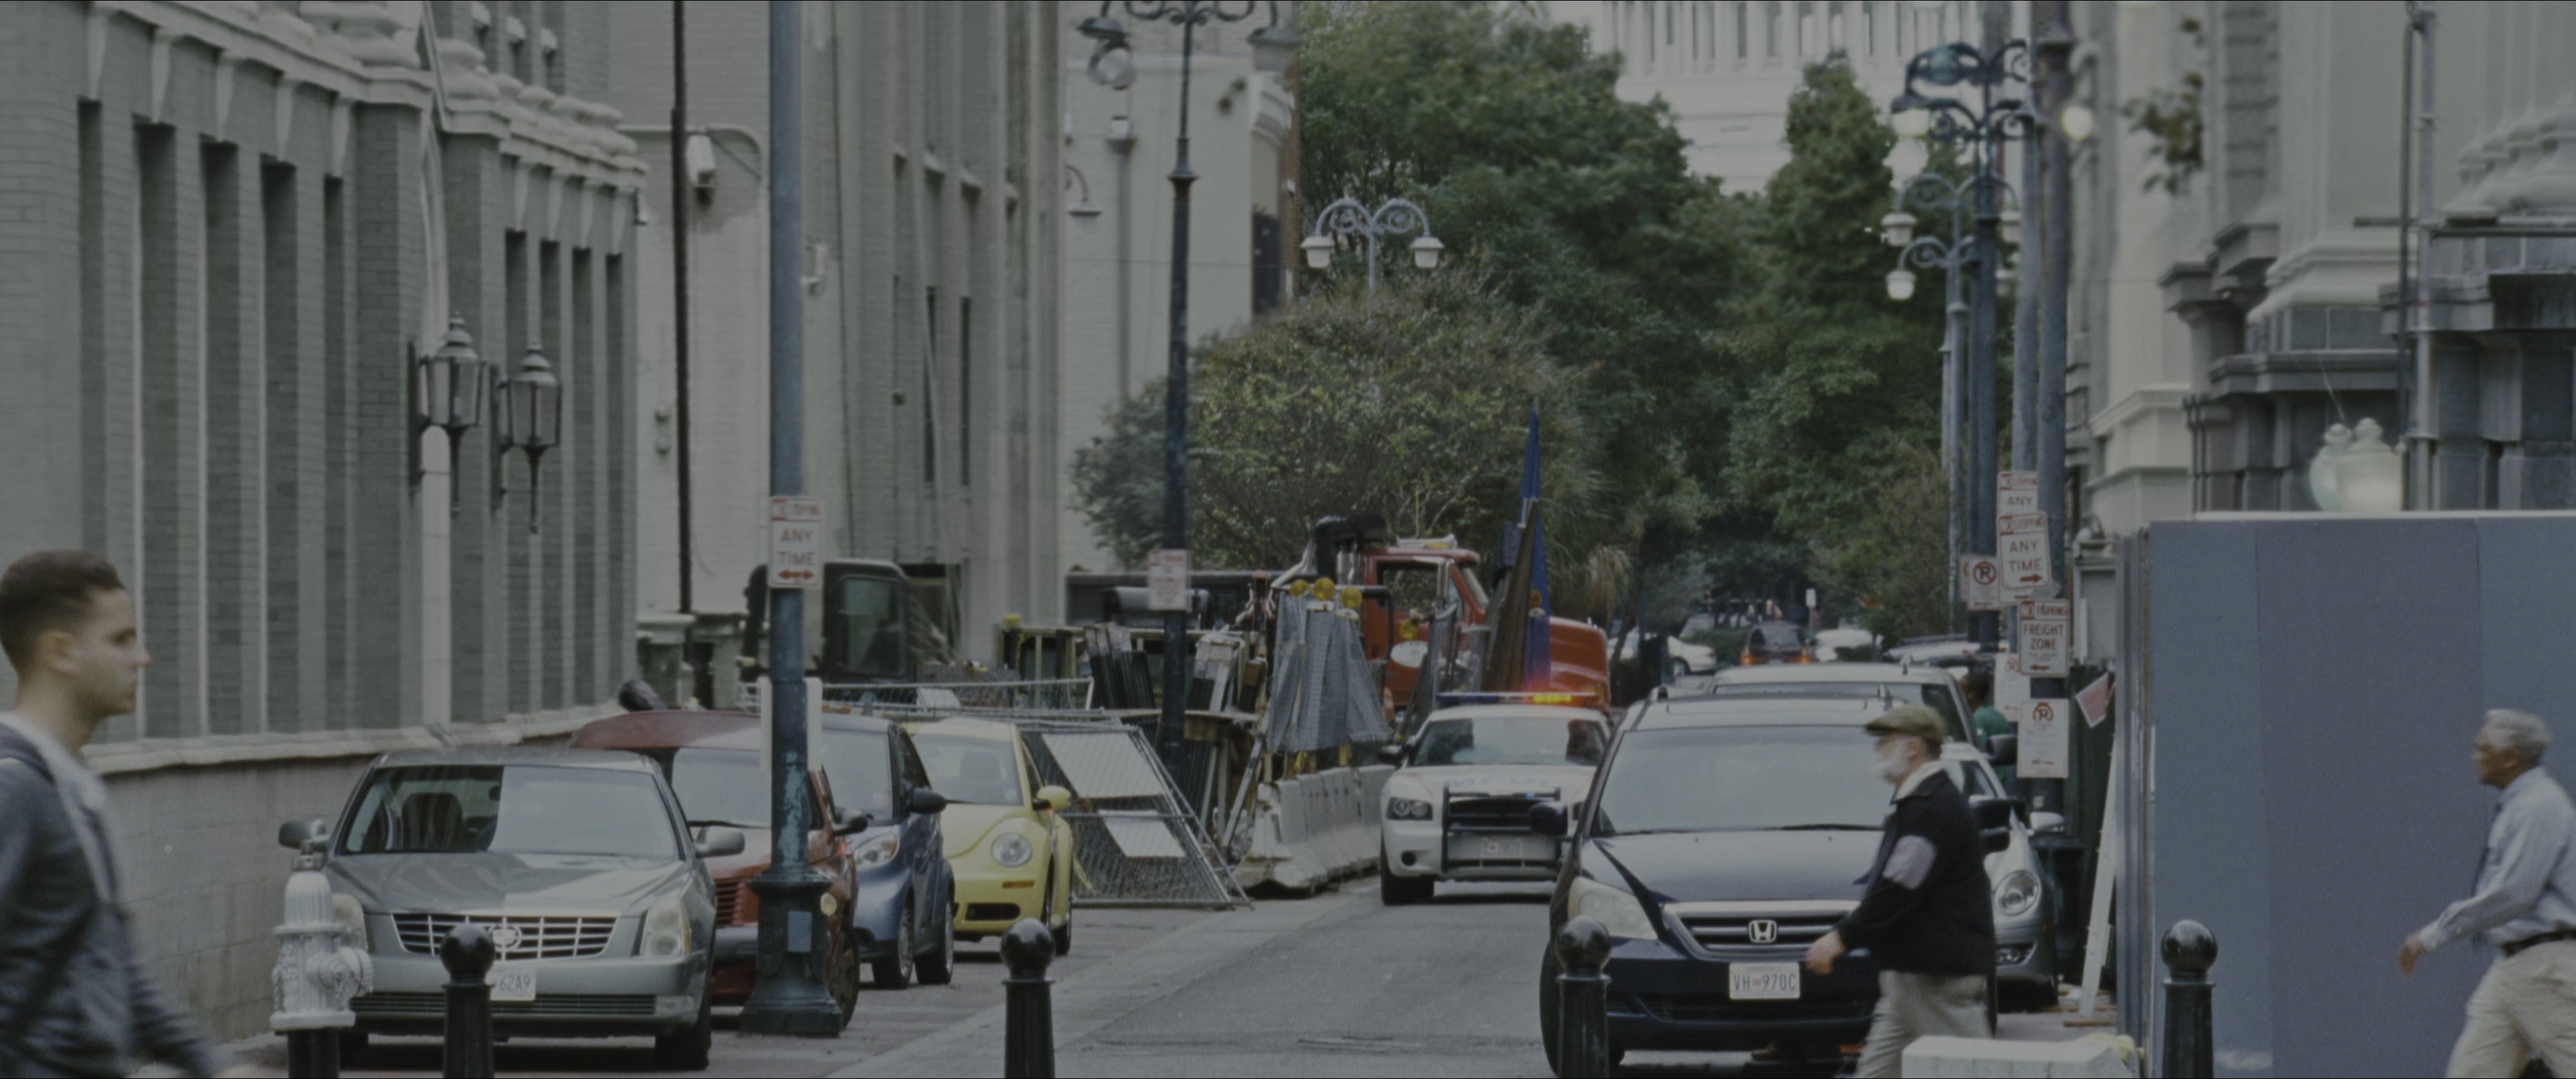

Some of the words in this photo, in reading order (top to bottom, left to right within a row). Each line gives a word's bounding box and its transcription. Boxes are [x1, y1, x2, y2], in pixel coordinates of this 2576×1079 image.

[2007, 496, 2033, 505] ANY
[781, 528, 813, 542] ANY
[2010, 540, 2038, 553] ANY
[778, 551, 816, 566] TIME
[2008, 558, 2042, 572] TIME
[2023, 623, 2063, 636] FREIGHT
[2031, 638, 2057, 650] ZONE
[499, 974, 531, 991] 62A9
[1733, 974, 1750, 991] VH
[1762, 973, 1796, 991] 970C
